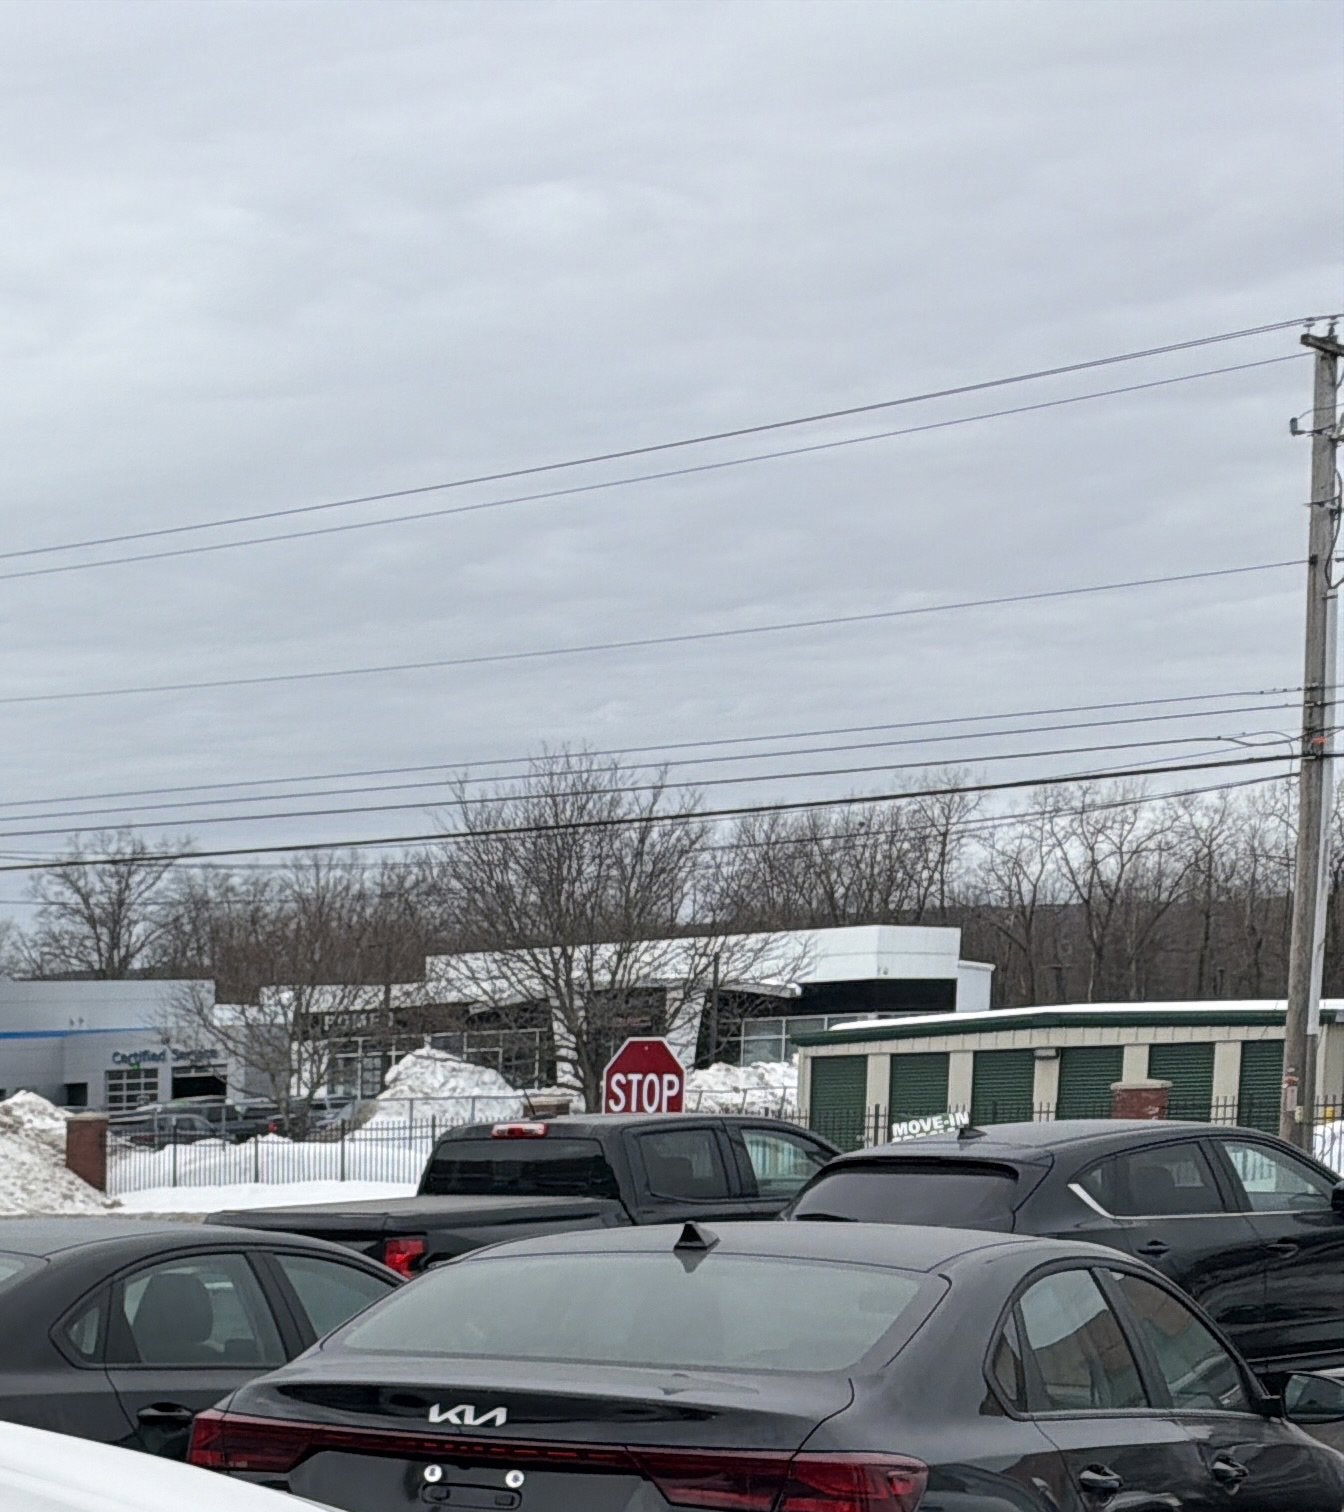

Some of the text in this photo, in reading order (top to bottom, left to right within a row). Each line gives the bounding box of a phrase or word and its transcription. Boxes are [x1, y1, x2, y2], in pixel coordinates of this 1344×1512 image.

[609, 1072, 680, 1113] STOP
[892, 1112, 970, 1137] MOVE-IN
[428, 1403, 508, 1427] KIA
